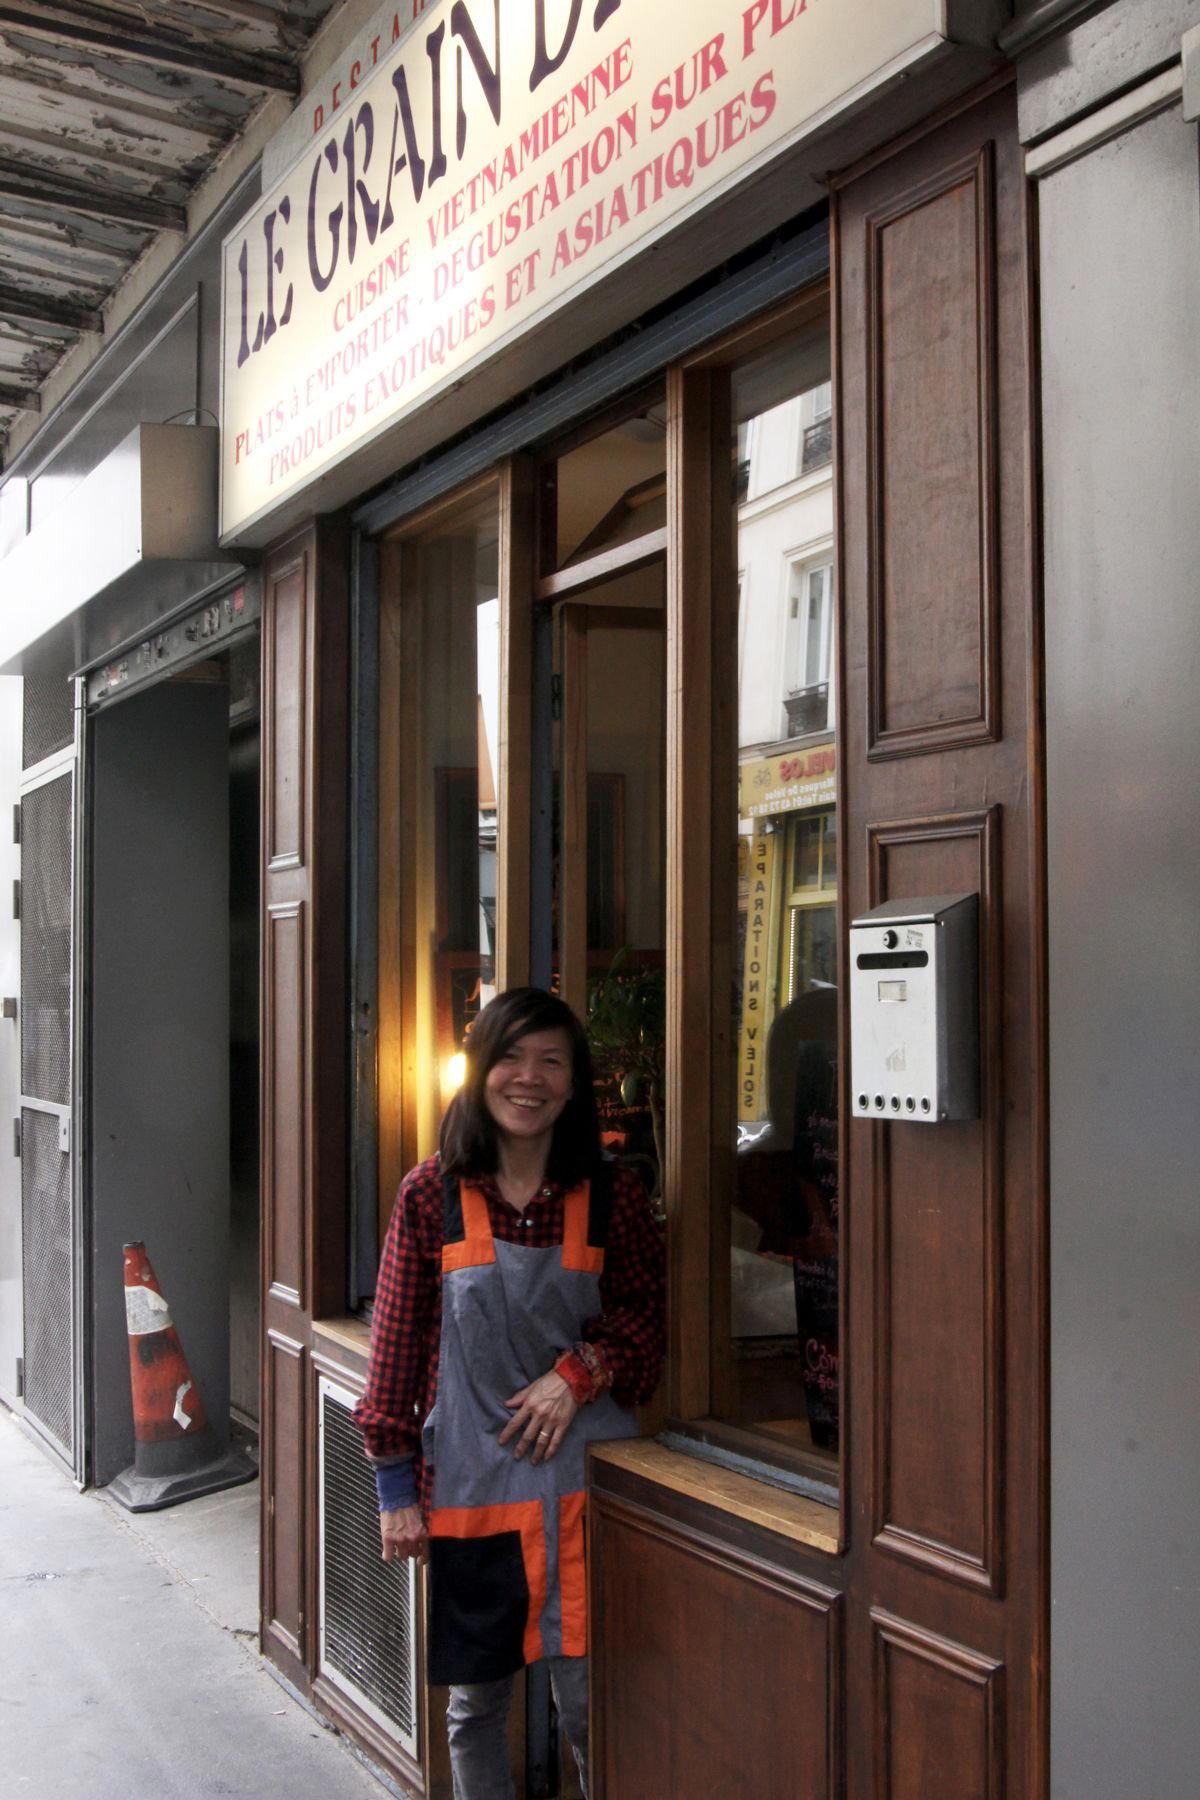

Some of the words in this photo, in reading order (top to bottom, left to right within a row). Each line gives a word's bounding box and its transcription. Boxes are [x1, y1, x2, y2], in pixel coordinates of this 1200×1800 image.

[235, 400, 285, 465] PLATS
[305, 294, 409, 407] EMPORTER
[433, 103, 639, 301] DEGUSTATION
[650, 32, 729, 132] SUR
[742, 0, 807, 61] PL
[236, 194, 294, 369] LE
[307, 0, 501, 292] GRAIN
[529, 0, 622, 93] D
[269, 393, 357, 486] PRODUITS
[363, 289, 497, 415] EXOTIQUES
[505, 250, 543, 312] ET
[549, 70, 777, 279] ASIATIQUES
[333, 238, 410, 332] CUISINE
[427, 38, 634, 248] VIETNAMIENNE
